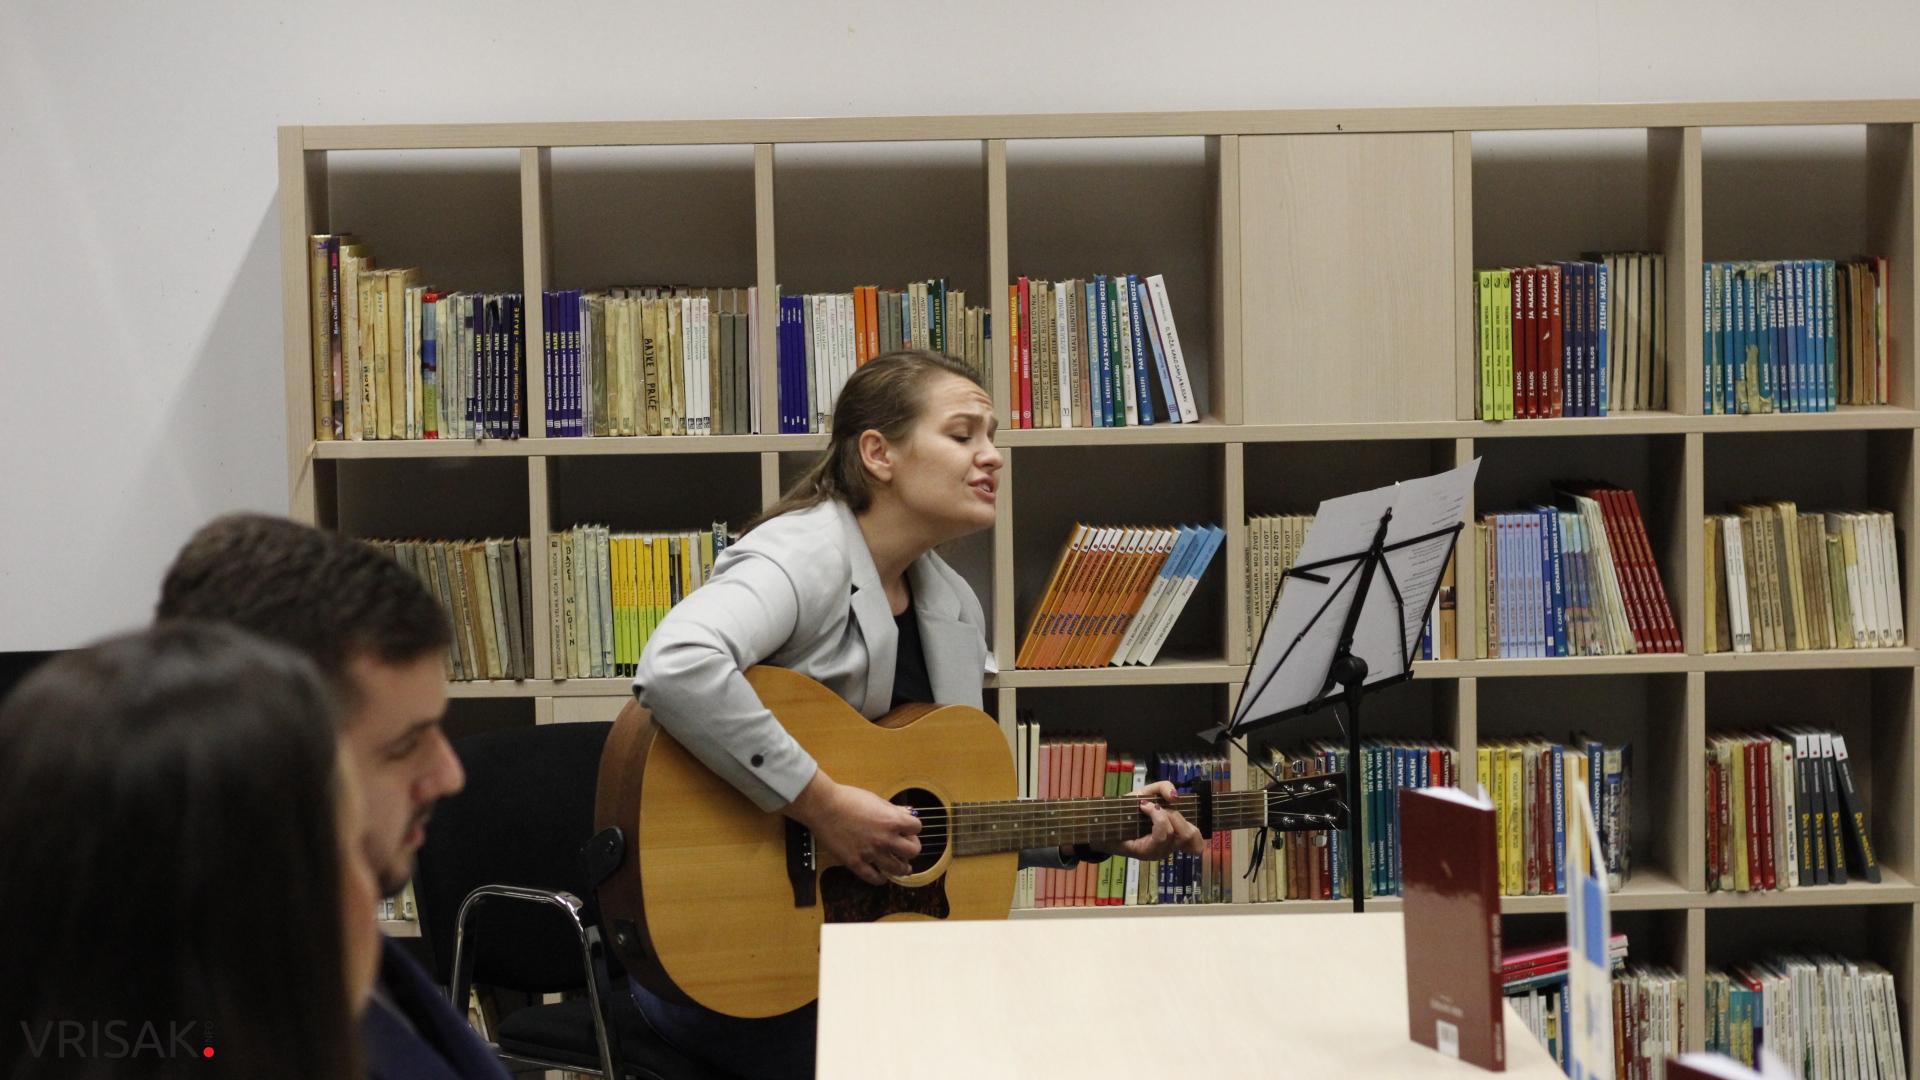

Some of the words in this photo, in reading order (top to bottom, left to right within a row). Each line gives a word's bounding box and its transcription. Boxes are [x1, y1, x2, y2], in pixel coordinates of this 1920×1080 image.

[1528, 311, 1534, 319] JA
[1542, 311, 1548, 319] JA
[1554, 307, 1559, 316] JA
[1368, 771, 1373, 780] PA
[1377, 770, 1382, 778] PA
